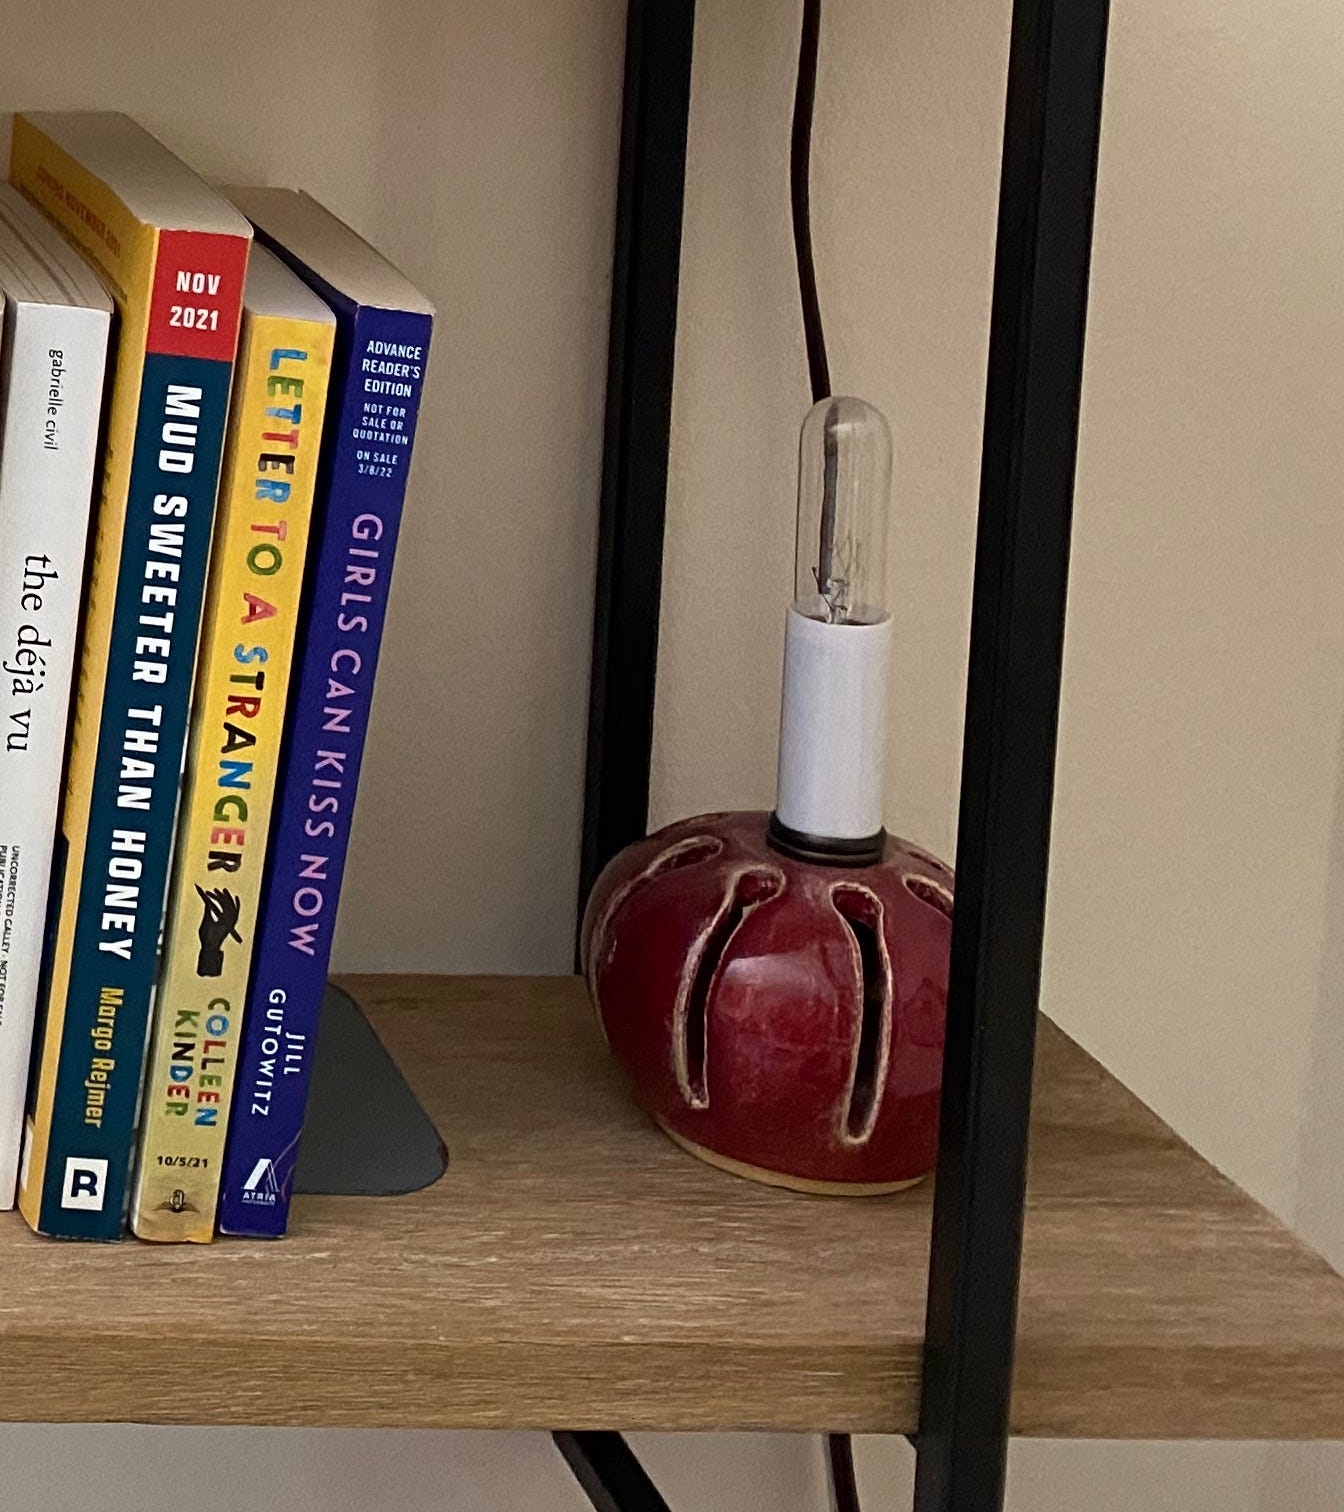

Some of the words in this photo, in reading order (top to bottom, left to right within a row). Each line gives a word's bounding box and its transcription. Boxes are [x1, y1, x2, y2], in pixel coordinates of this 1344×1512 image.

[169, 306, 219, 331] 2021
[176, 271, 220, 295] NOV
[47, 350, 66, 415] gabrielle
[362, 359, 420, 379] READER'S
[367, 340, 422, 360] ADVANCE
[364, 378, 411, 397] EDITION
[44, 420, 59, 450] civil
[158, 385, 203, 474] MUD
[255, 348, 307, 504] LETTER
[19, 554, 59, 611] the
[246, 520, 287, 576] TO
[337, 513, 384, 633] GIRLS
[132, 493, 188, 685] SWEETER
[240, 592, 278, 624] A
[3, 624, 51, 696] déjà
[321, 649, 361, 733] CAN
[7, 709, 31, 752] vu
[117, 704, 163, 810] THAN
[207, 644, 269, 873] STRANGER
[304, 749, 346, 837] KISS
[98, 828, 147, 961] HONEY
[287, 853, 329, 957] NOW
[91, 987, 124, 1051] Margo
[251, 989, 286, 1116] GUTOWITZ
[283, 1034, 305, 1074] JILL
[84, 1057, 115, 1128] Rejmer
[165, 1009, 200, 1116] KINDER
[195, 997, 230, 1126] COLLEEN
[157, 1155, 208, 1168] 10/5/21
